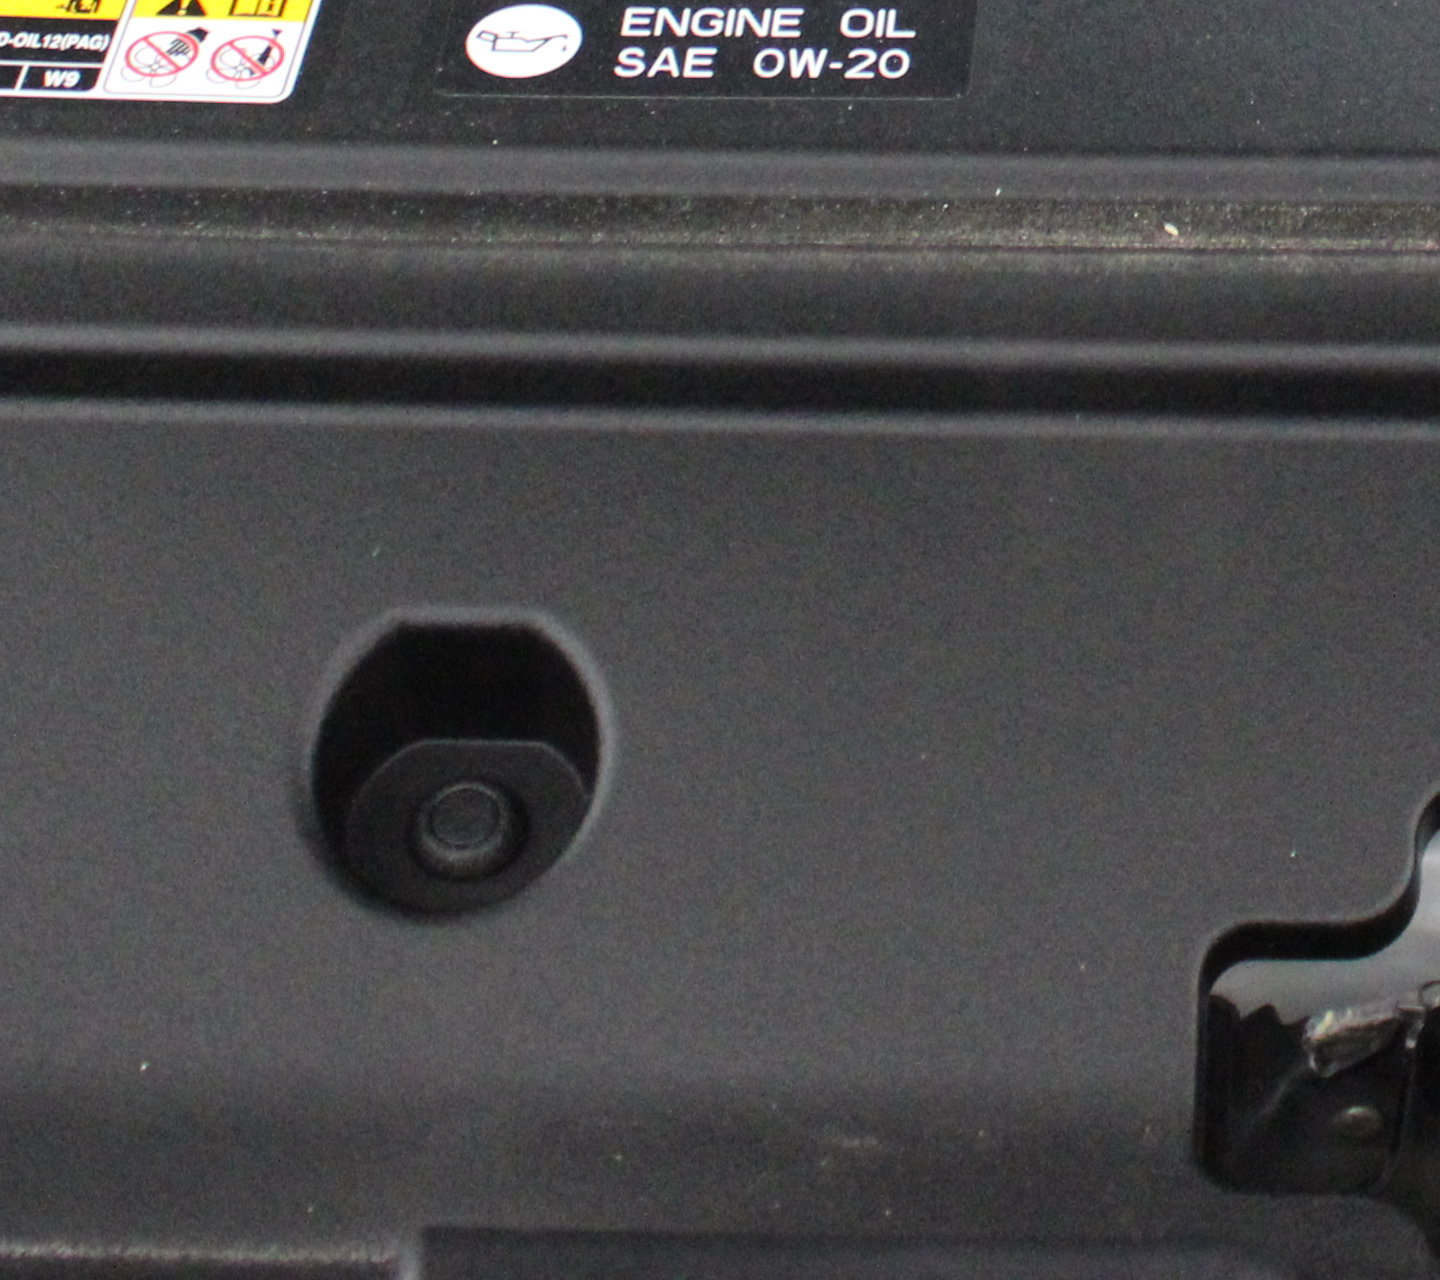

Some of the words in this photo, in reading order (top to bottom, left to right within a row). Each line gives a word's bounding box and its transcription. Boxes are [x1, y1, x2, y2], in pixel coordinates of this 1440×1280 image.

[620, 6, 805, 38] ENGINE
[839, 7, 916, 39] OIL
[43, 70, 80, 88] W9
[614, 46, 718, 78] SAE
[753, 47, 911, 79] 0W-20
